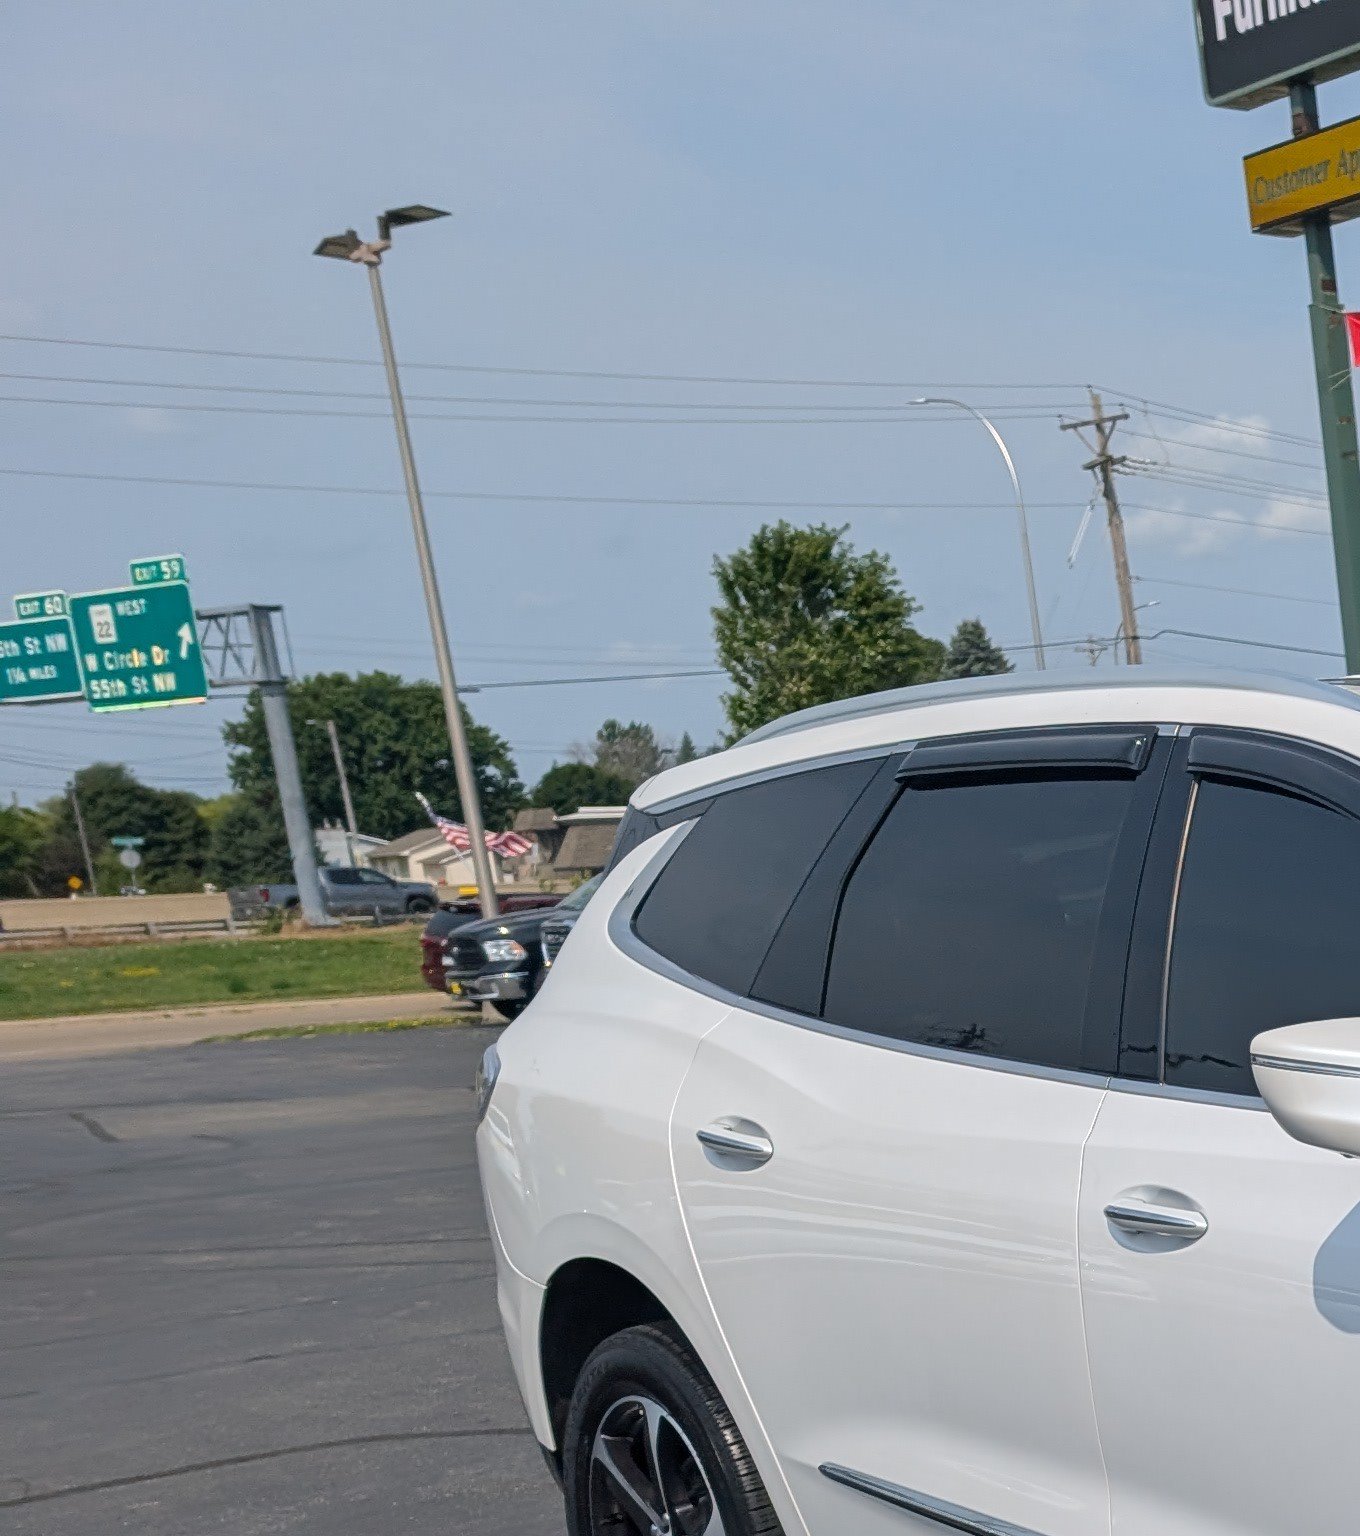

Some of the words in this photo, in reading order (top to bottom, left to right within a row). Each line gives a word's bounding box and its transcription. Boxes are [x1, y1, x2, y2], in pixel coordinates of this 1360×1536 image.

[1254, 160, 1330, 204] Customer
[160, 560, 180, 579] 59
[44, 596, 62, 614] 60
[115, 598, 145, 616] WEST
[97, 622, 112, 638] 22
[24, 636, 42, 655] St
[103, 648, 147, 671] Circle
[151, 645, 169, 665] Dr
[90, 679, 127, 699] 55th
[131, 675, 149, 694] St
[152, 672, 176, 692] NW
